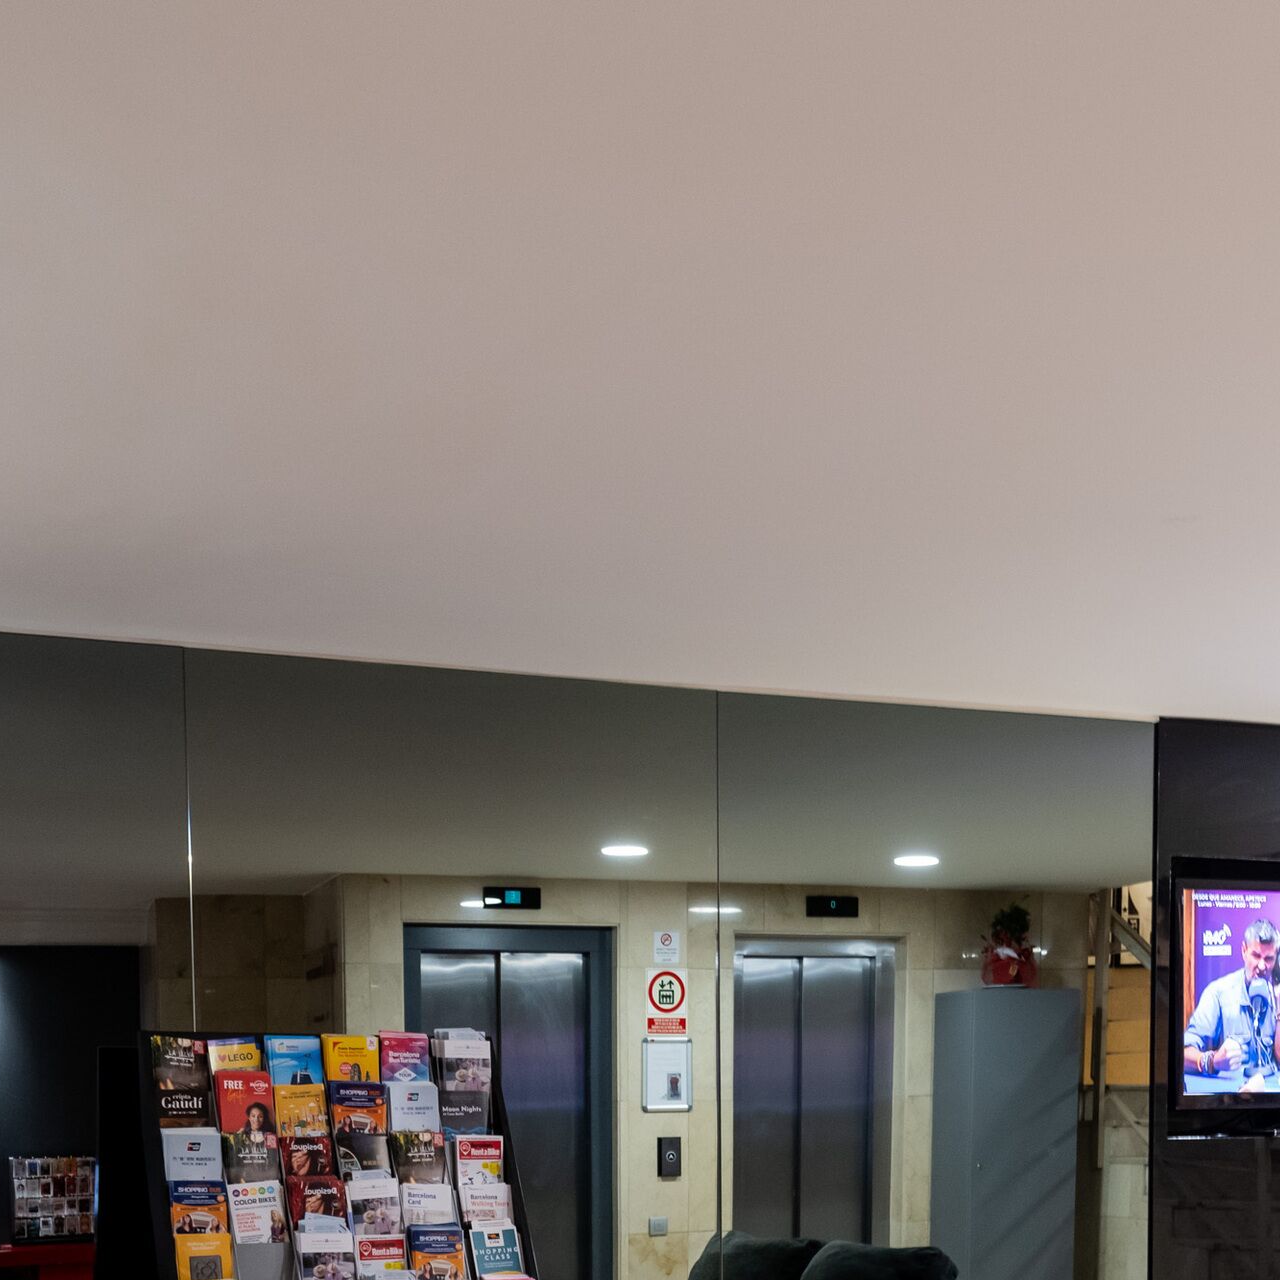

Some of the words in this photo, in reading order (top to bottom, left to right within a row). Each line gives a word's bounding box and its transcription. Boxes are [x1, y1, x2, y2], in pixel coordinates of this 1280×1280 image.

[227, 1052, 254, 1062] LEGO
[388, 1051, 420, 1059] Barcelona
[223, 1079, 244, 1090] FREE
[161, 1097, 203, 1109] Gaudí
[461, 1105, 482, 1114] Nights
[234, 1198, 257, 1206] COLOR
[258, 1196, 277, 1204] BIKES
[471, 1200, 494, 1208] Walking
[475, 1246, 518, 1255] SHOPPING
[484, 1253, 511, 1261] CLASS
